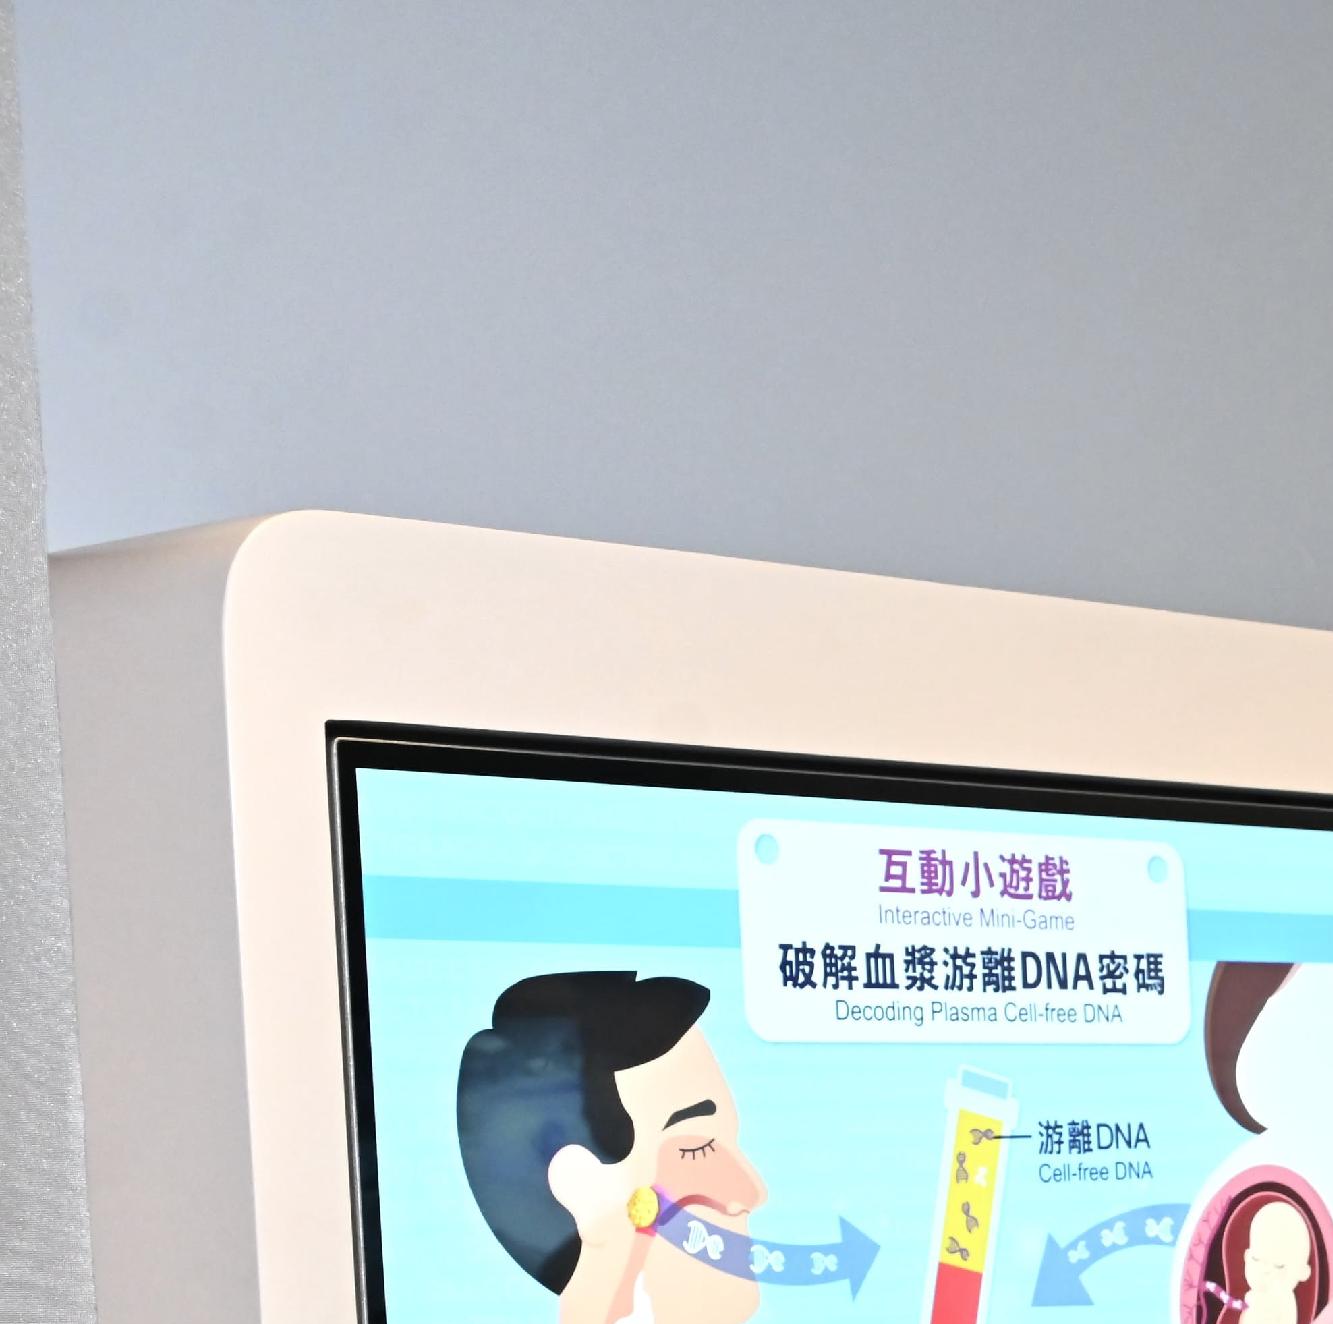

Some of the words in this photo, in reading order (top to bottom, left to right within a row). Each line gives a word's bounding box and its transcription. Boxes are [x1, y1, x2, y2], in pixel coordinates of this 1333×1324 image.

[879, 848, 1073, 902] 互動小遊戲
[879, 905, 973, 926] Interactive
[980, 908, 1075, 930] Mini-Game
[779, 942, 1165, 995] 破解血漿游離DNA密碼
[836, 1000, 924, 1026] Decoding
[931, 1002, 997, 1023] Plasma
[1004, 1003, 1077, 1023] Cell-free
[1084, 1004, 1122, 1023] DNA
[1039, 1120, 1151, 1155] 游離DNA
[1039, 1163, 1109, 1183] Cell-free
[1116, 1161, 1153, 1180] DNA
